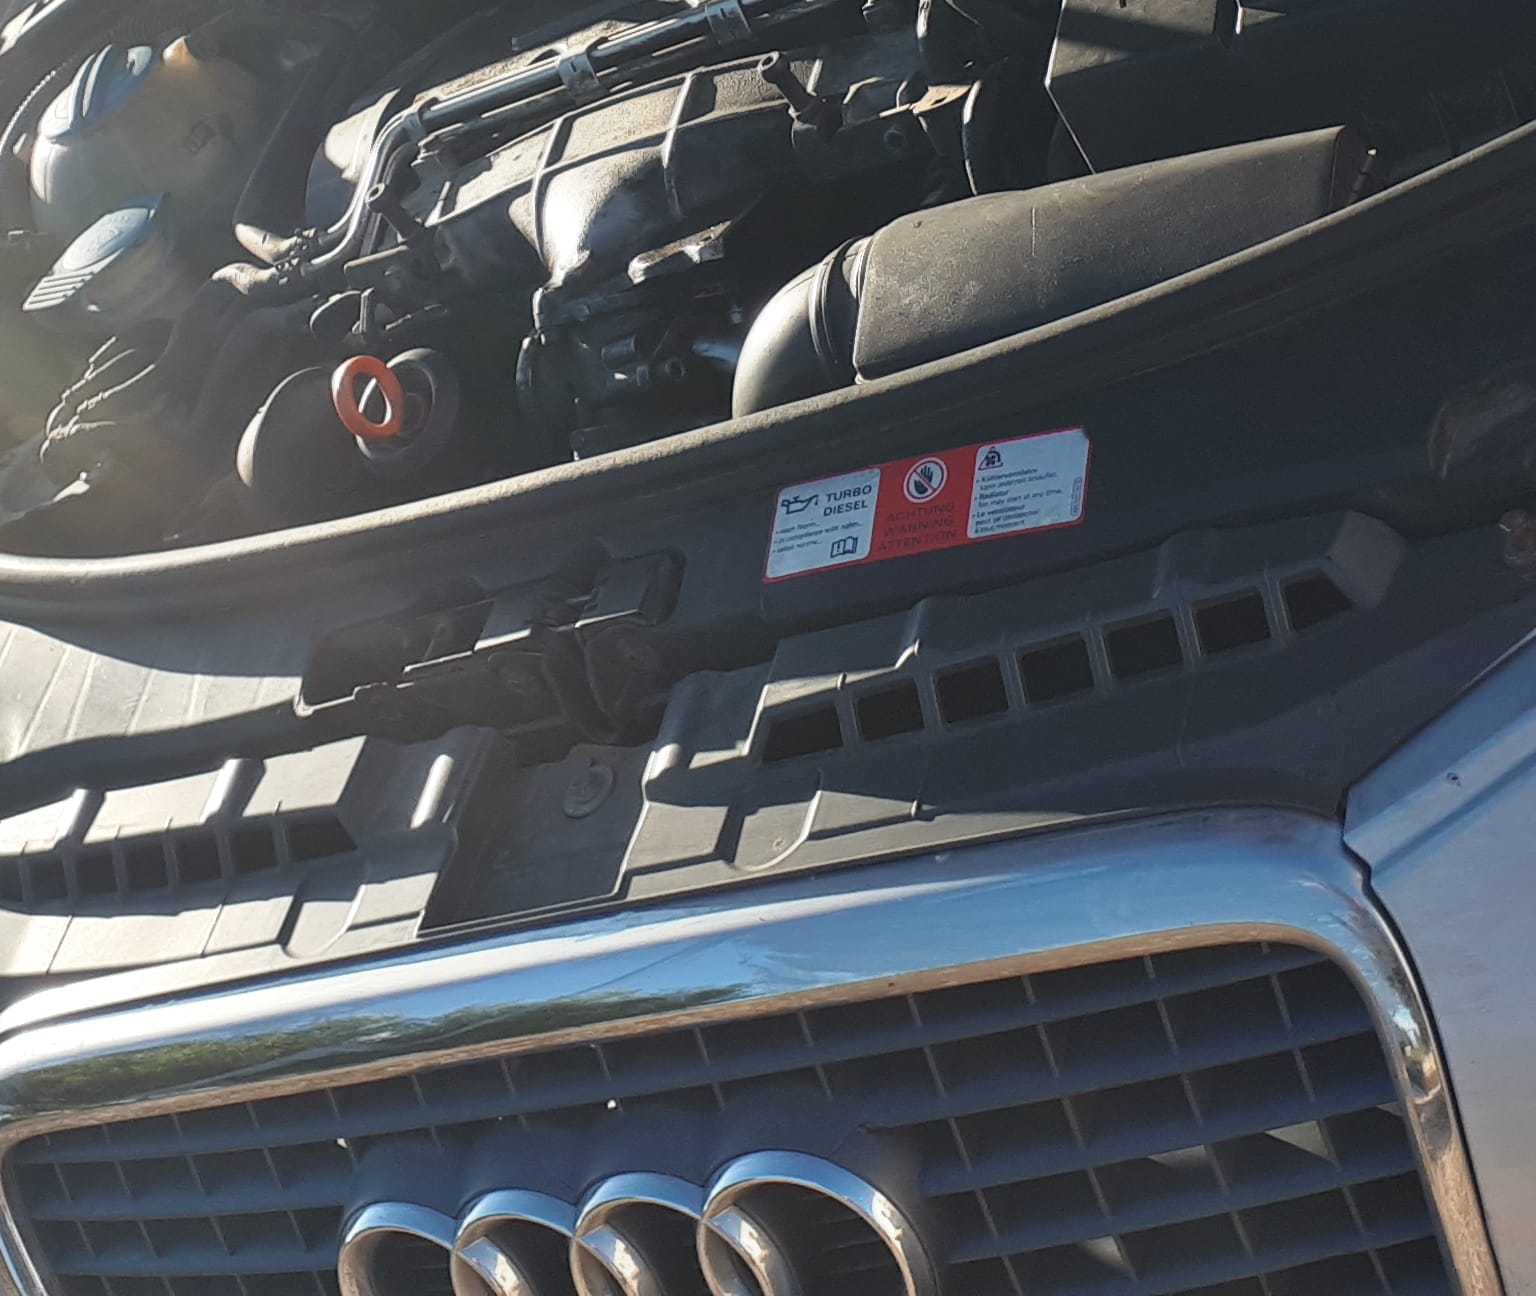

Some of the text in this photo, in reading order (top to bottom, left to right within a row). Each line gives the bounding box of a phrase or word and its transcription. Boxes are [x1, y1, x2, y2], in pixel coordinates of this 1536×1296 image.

[825, 484, 873, 503] TURBO
[823, 500, 869, 517] DIESEL
[887, 502, 955, 521] ACHTUNG
[884, 516, 954, 537] WARNING
